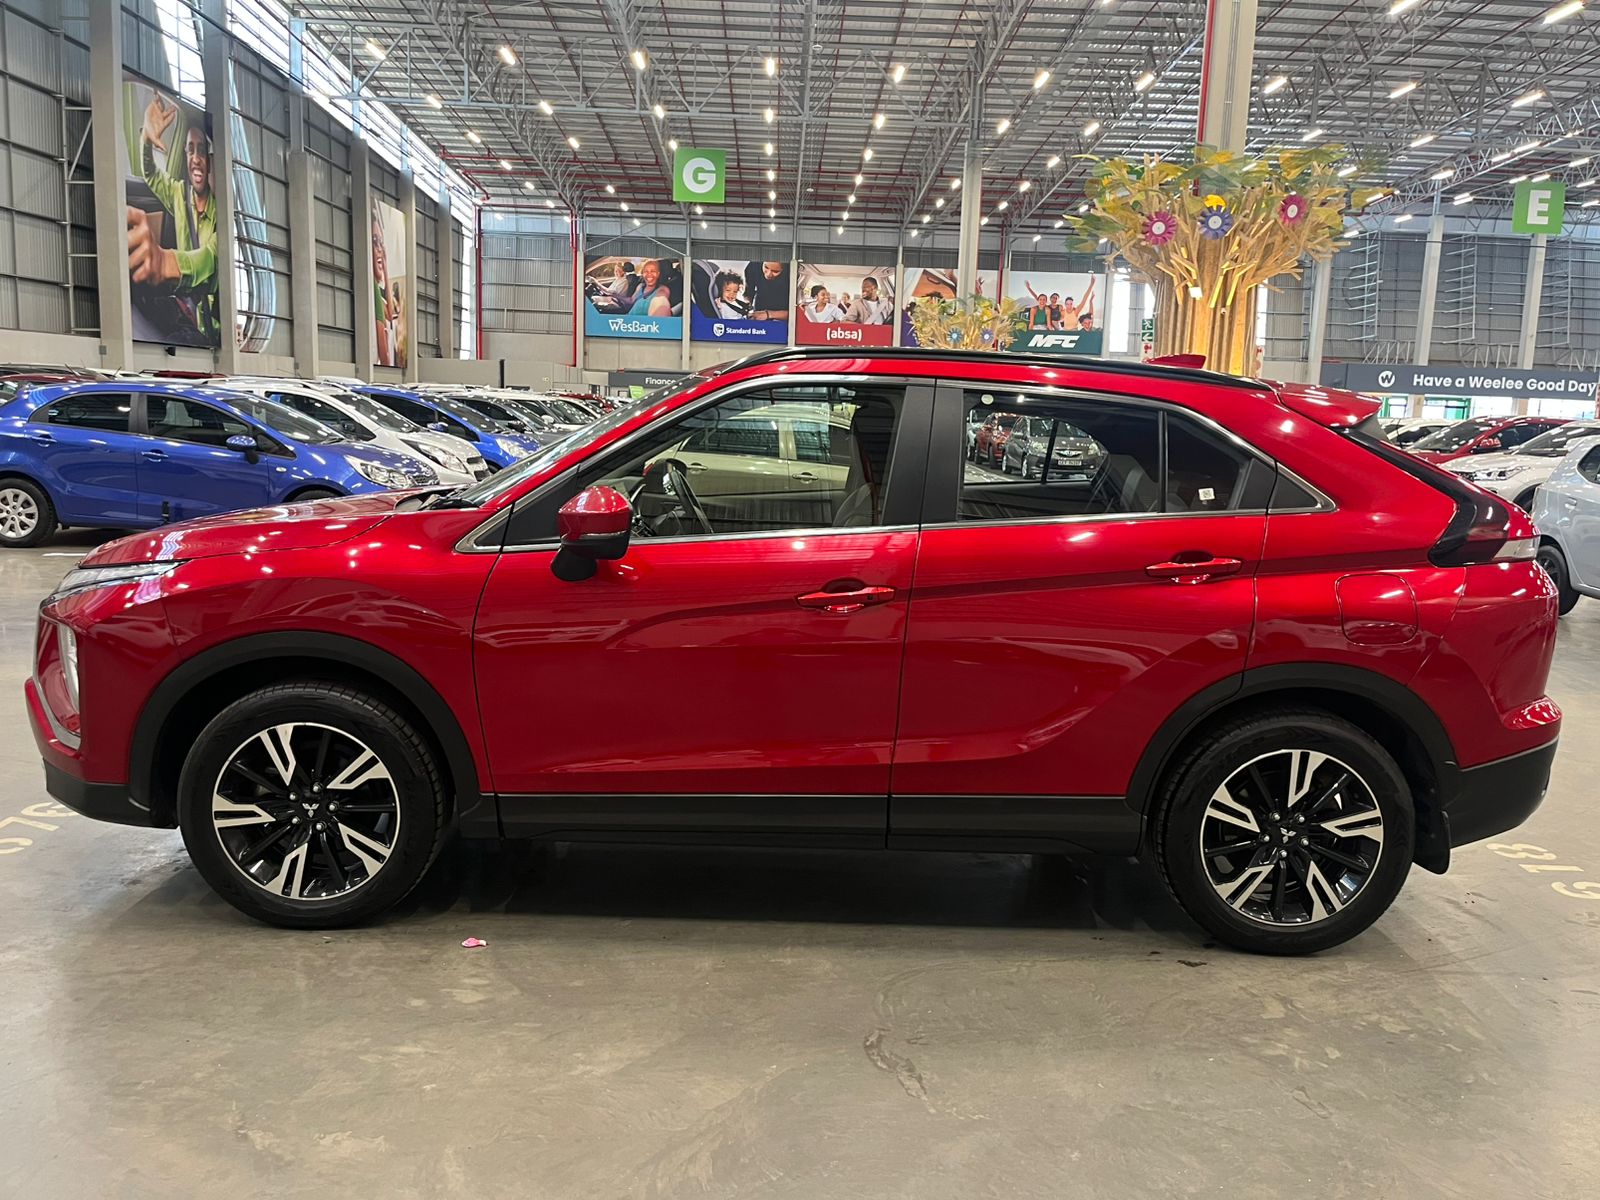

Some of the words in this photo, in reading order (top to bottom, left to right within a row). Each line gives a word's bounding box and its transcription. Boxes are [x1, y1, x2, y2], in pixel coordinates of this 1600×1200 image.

[683, 157, 716, 194] G
[1527, 189, 1551, 225] E
[609, 318, 660, 333] WesBank
[726, 327, 751, 335] Standard
[1027, 334, 1080, 348] MFC
[1413, 374, 1452, 387] Have
[1454, 377, 1465, 388] a
[1468, 376, 1524, 389] Weelee
[1526, 378, 1565, 392] Good
[1567, 380, 1597, 397] Day
